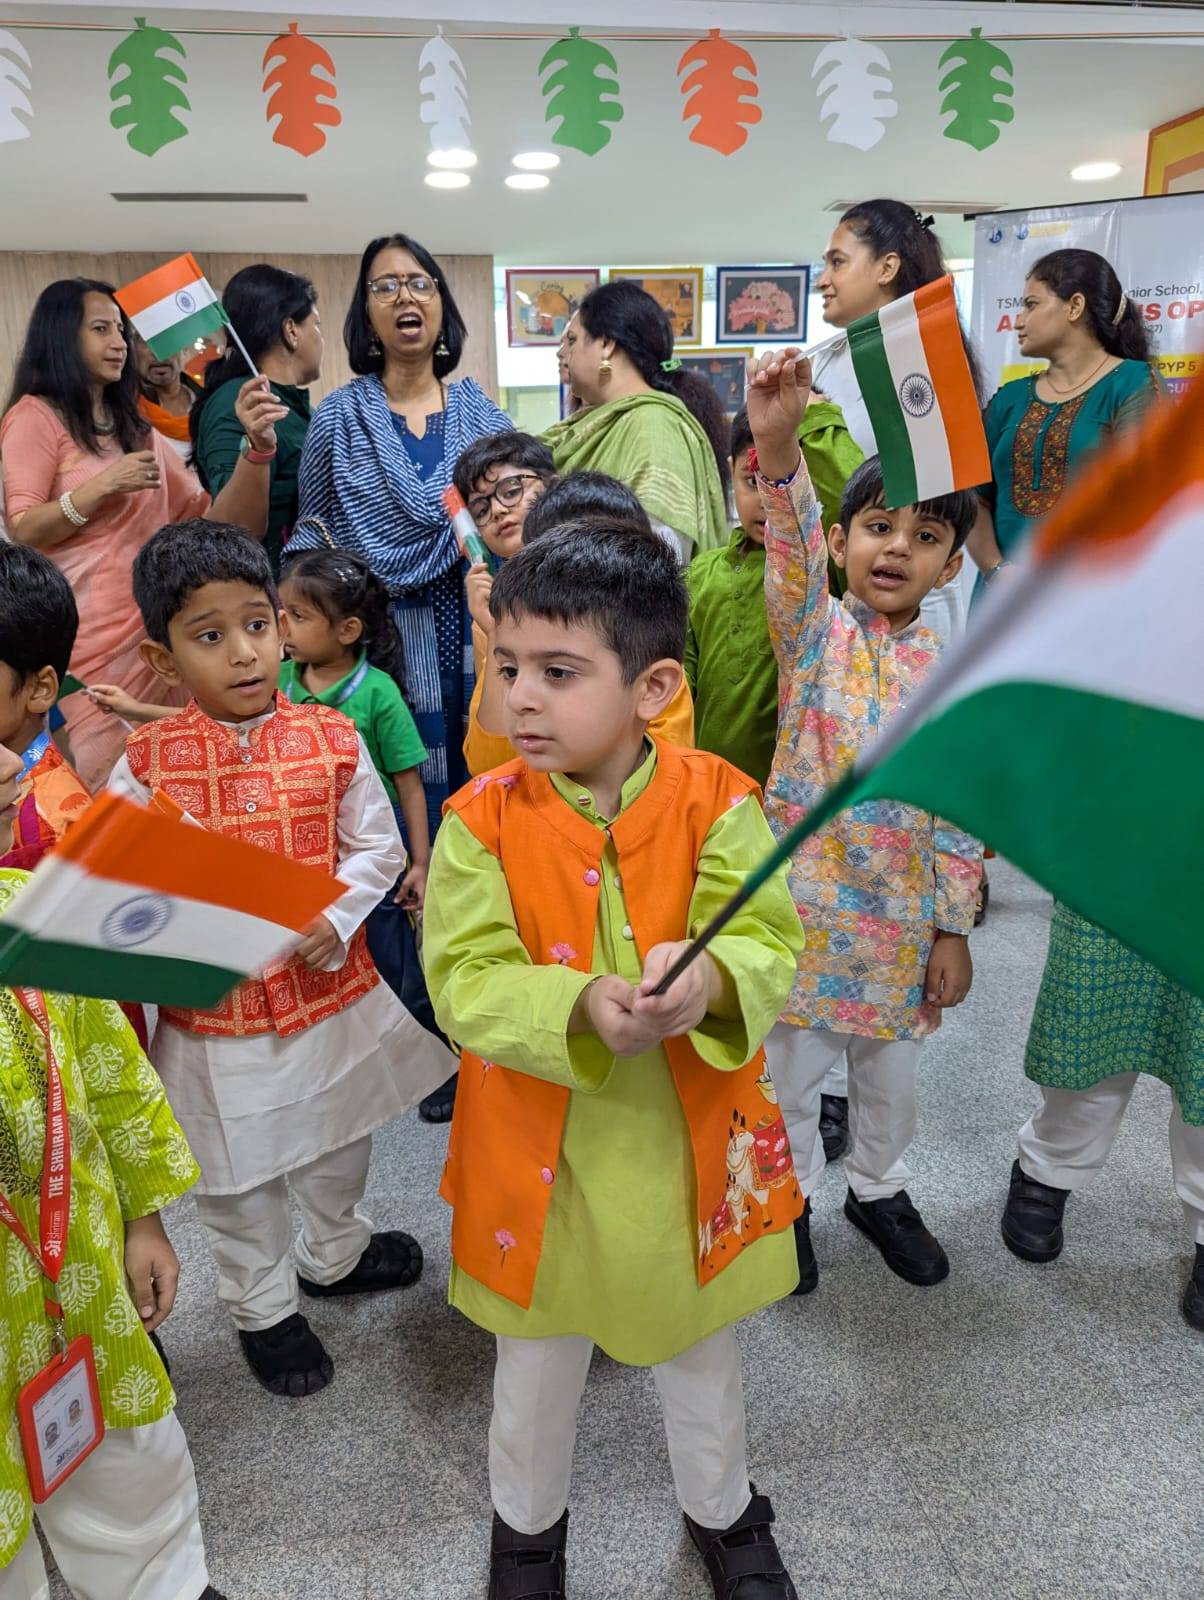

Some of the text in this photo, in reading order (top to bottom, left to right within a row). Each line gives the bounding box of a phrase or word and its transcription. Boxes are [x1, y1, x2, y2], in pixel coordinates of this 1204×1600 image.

[1128, 287, 1152, 299] nior
[51, 1114, 65, 1172] SHRIRAM
[49, 1174, 64, 1199] THE
